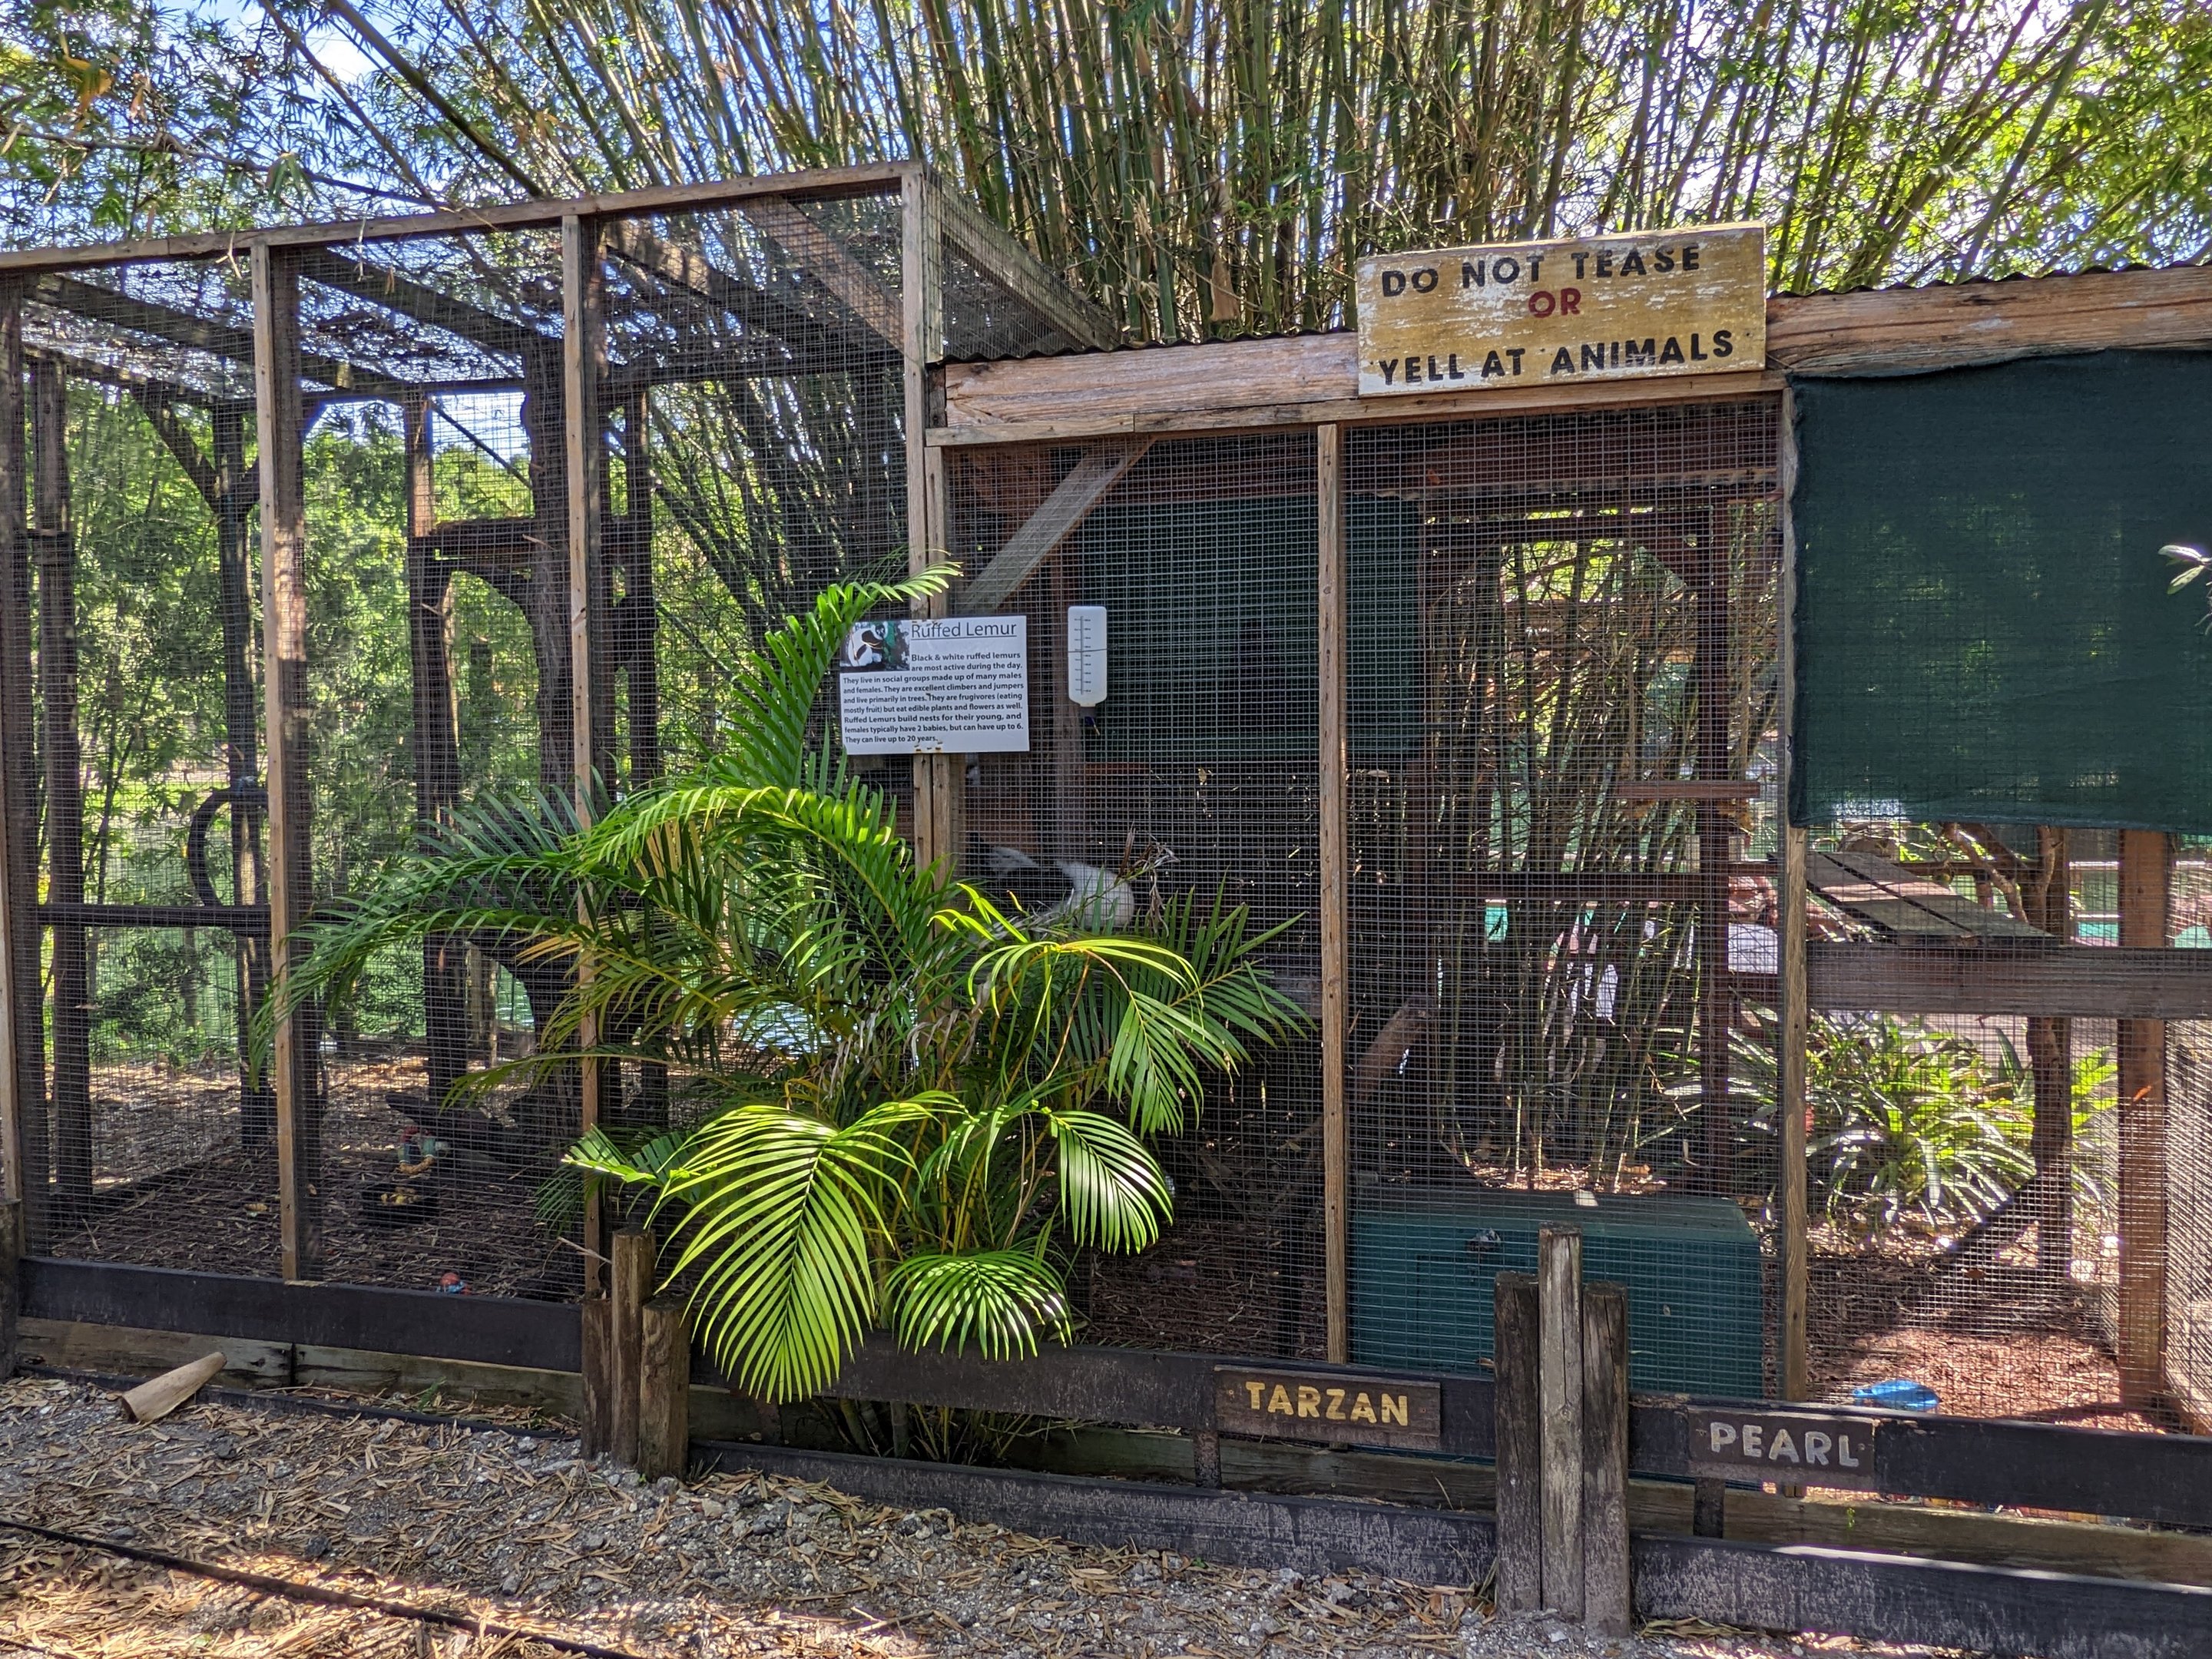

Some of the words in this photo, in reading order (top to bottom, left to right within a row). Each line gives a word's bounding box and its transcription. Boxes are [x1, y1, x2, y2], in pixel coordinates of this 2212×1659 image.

[1382, 268, 1438, 297] DO
[1462, 255, 1544, 289] NOT
[1571, 246, 1699, 279] TEASE
[1528, 287, 1581, 318] OR
[1379, 353, 1464, 385] YELL
[1481, 348, 1525, 378] AT
[1551, 329, 1734, 375] ANIMALS
[912, 622, 960, 637] Ruffed
[967, 622, 1016, 636] Lemur
[869, 696, 898, 704] primarily
[997, 692, 1022, 700] (eating
[1246, 1382, 1409, 1427] TARZAN
[1710, 1422, 1859, 1468] PEARL
